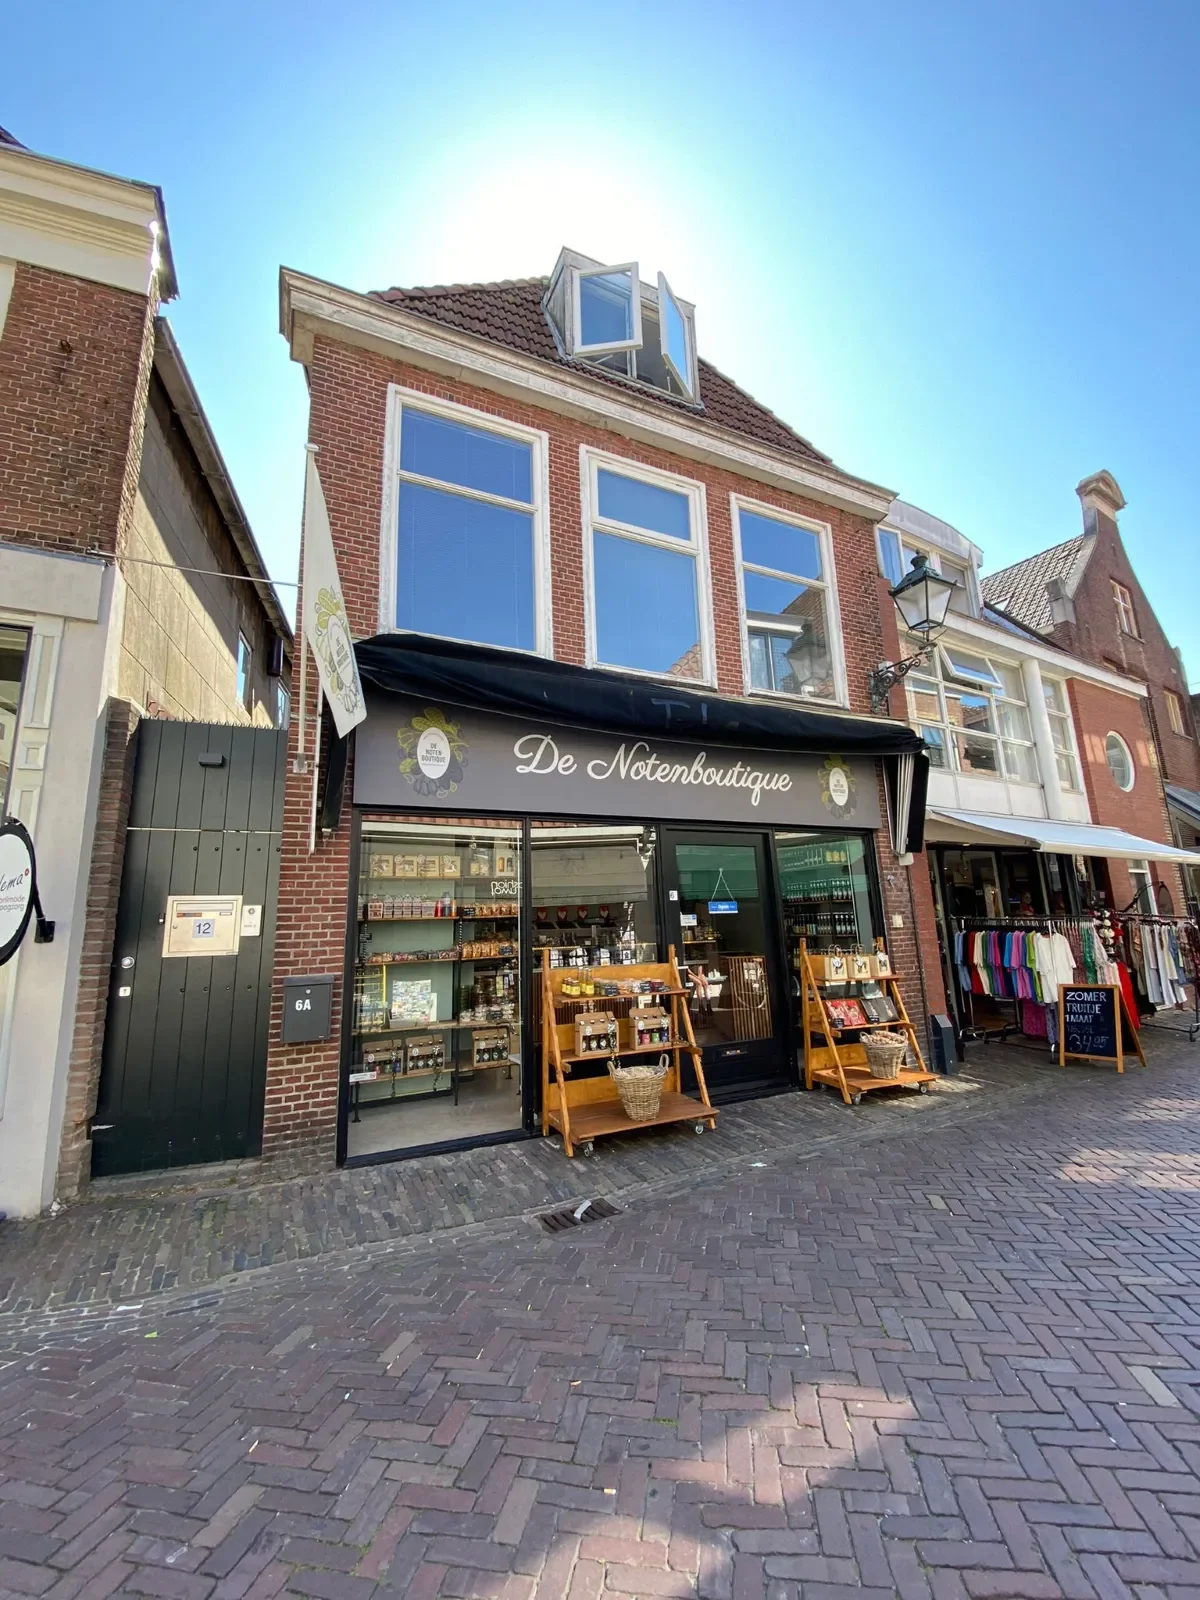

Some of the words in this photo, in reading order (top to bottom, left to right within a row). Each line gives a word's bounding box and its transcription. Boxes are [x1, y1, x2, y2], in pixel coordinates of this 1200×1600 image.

[513, 735, 578, 776] De
[586, 742, 793, 807] Notenboutique
[196, 922, 211, 934] 12
[1066, 991, 1107, 1002] ZOMER
[295, 999, 312, 1011] 6A
[1065, 1003, 1102, 1014] TRUITJE
